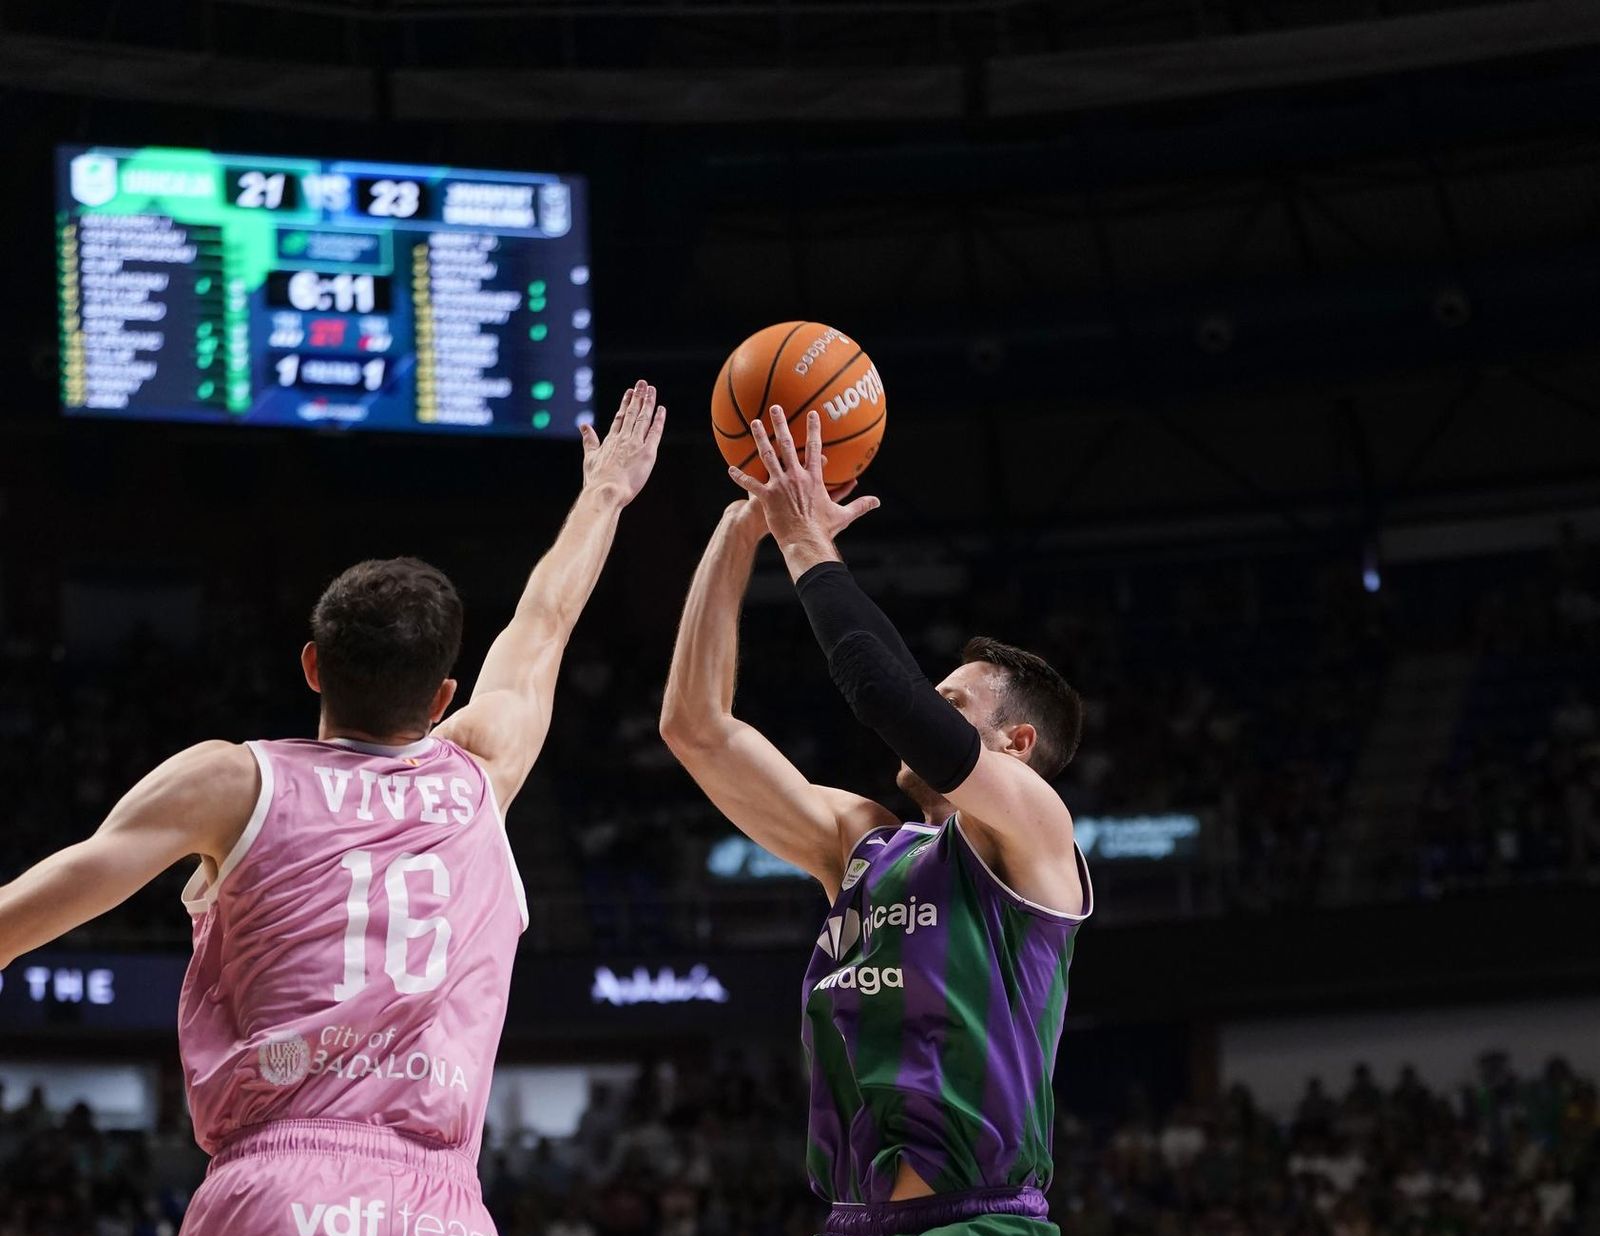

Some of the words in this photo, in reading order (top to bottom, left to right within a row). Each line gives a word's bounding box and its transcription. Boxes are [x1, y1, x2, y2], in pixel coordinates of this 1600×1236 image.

[237, 171, 286, 209] 21
[367, 179, 420, 218] 23
[288, 269, 375, 314] 6:11
[275, 354, 300, 387] 1
[362, 357, 386, 391] 1
[314, 765, 475, 825] VIVES
[333, 850, 452, 1002] 16
[24, 966, 116, 1004] THE
[320, 1025, 365, 1049] City
[369, 1027, 397, 1048] of
